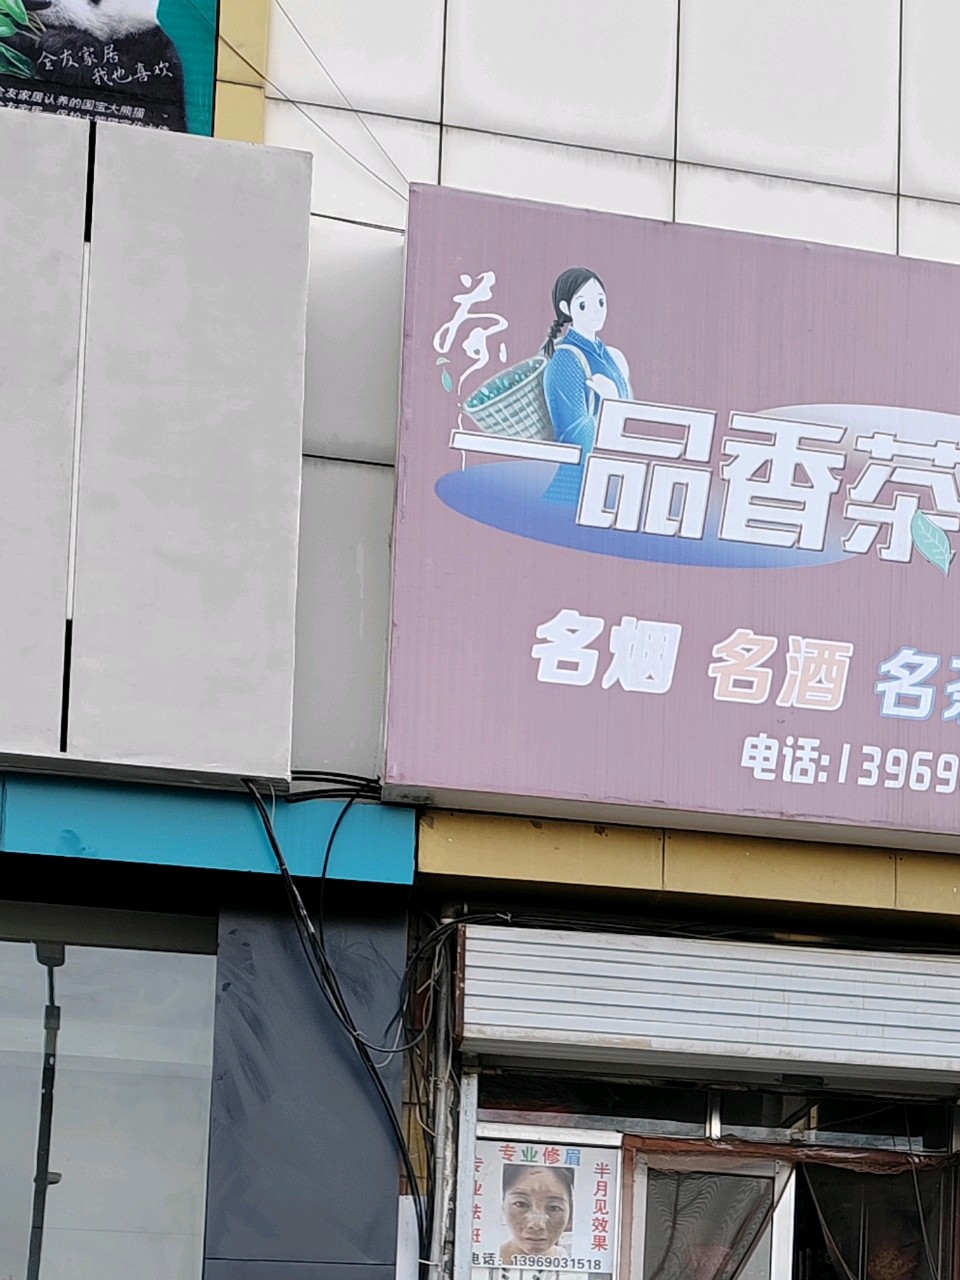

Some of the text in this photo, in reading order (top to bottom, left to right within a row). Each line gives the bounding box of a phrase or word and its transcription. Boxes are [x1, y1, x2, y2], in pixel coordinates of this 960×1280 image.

[37, 44, 119, 71] 全友家居
[91, 61, 173, 86] 我也喜欢
[530, 608, 683, 695] 名烟
[707, 627, 854, 711] 名酒
[498, 1144, 582, 1167] 专业修眉
[591, 1162, 611, 1252] 半月见效果
